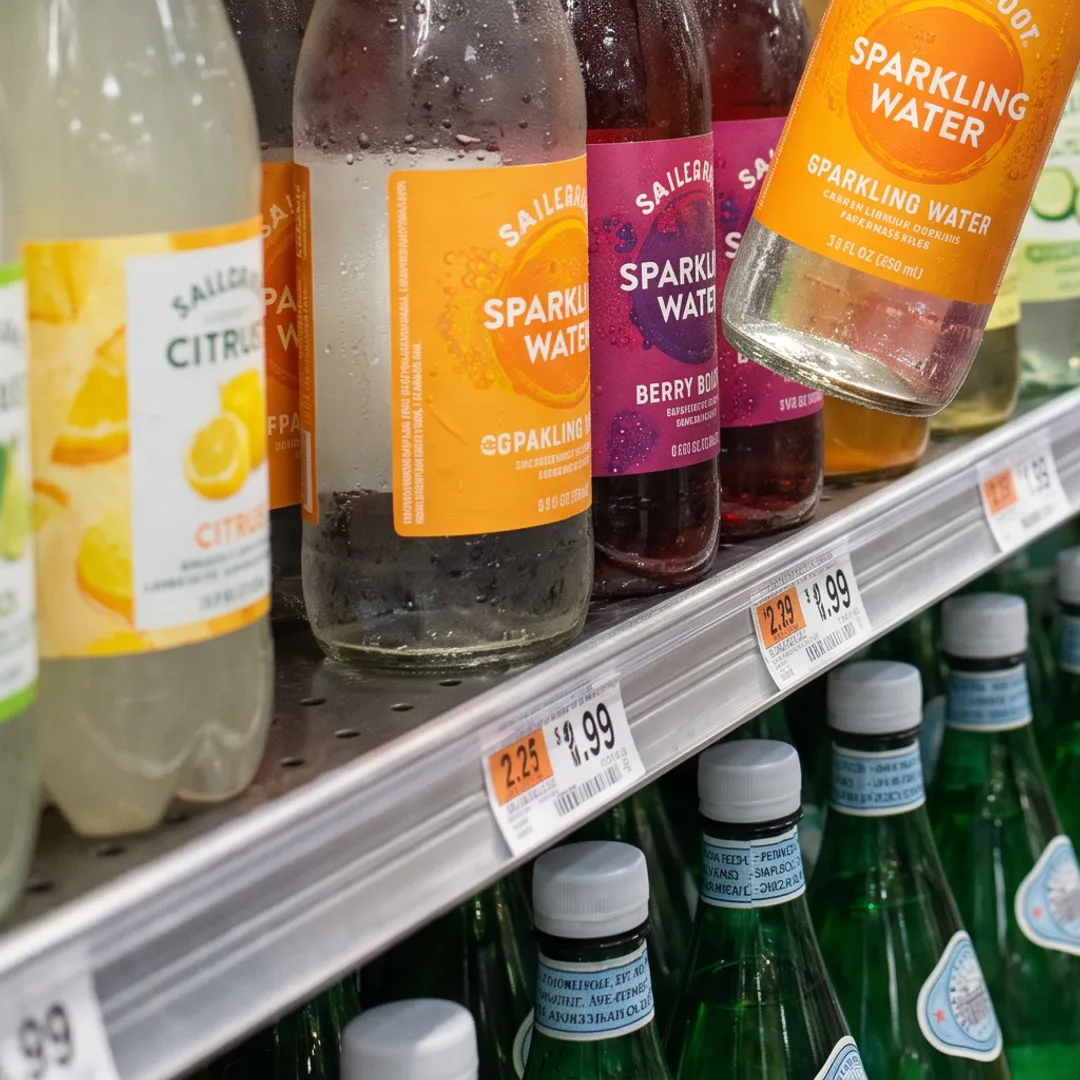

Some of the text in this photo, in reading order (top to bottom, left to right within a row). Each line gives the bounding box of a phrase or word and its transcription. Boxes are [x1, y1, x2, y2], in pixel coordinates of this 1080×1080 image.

[849, 36, 1030, 121] SPARKLING
[871, 82, 986, 149] WATER
[927, 199, 993, 237] WATER
[636, 376, 694, 406] BERRY
[501, 737, 540, 788] 2.25
